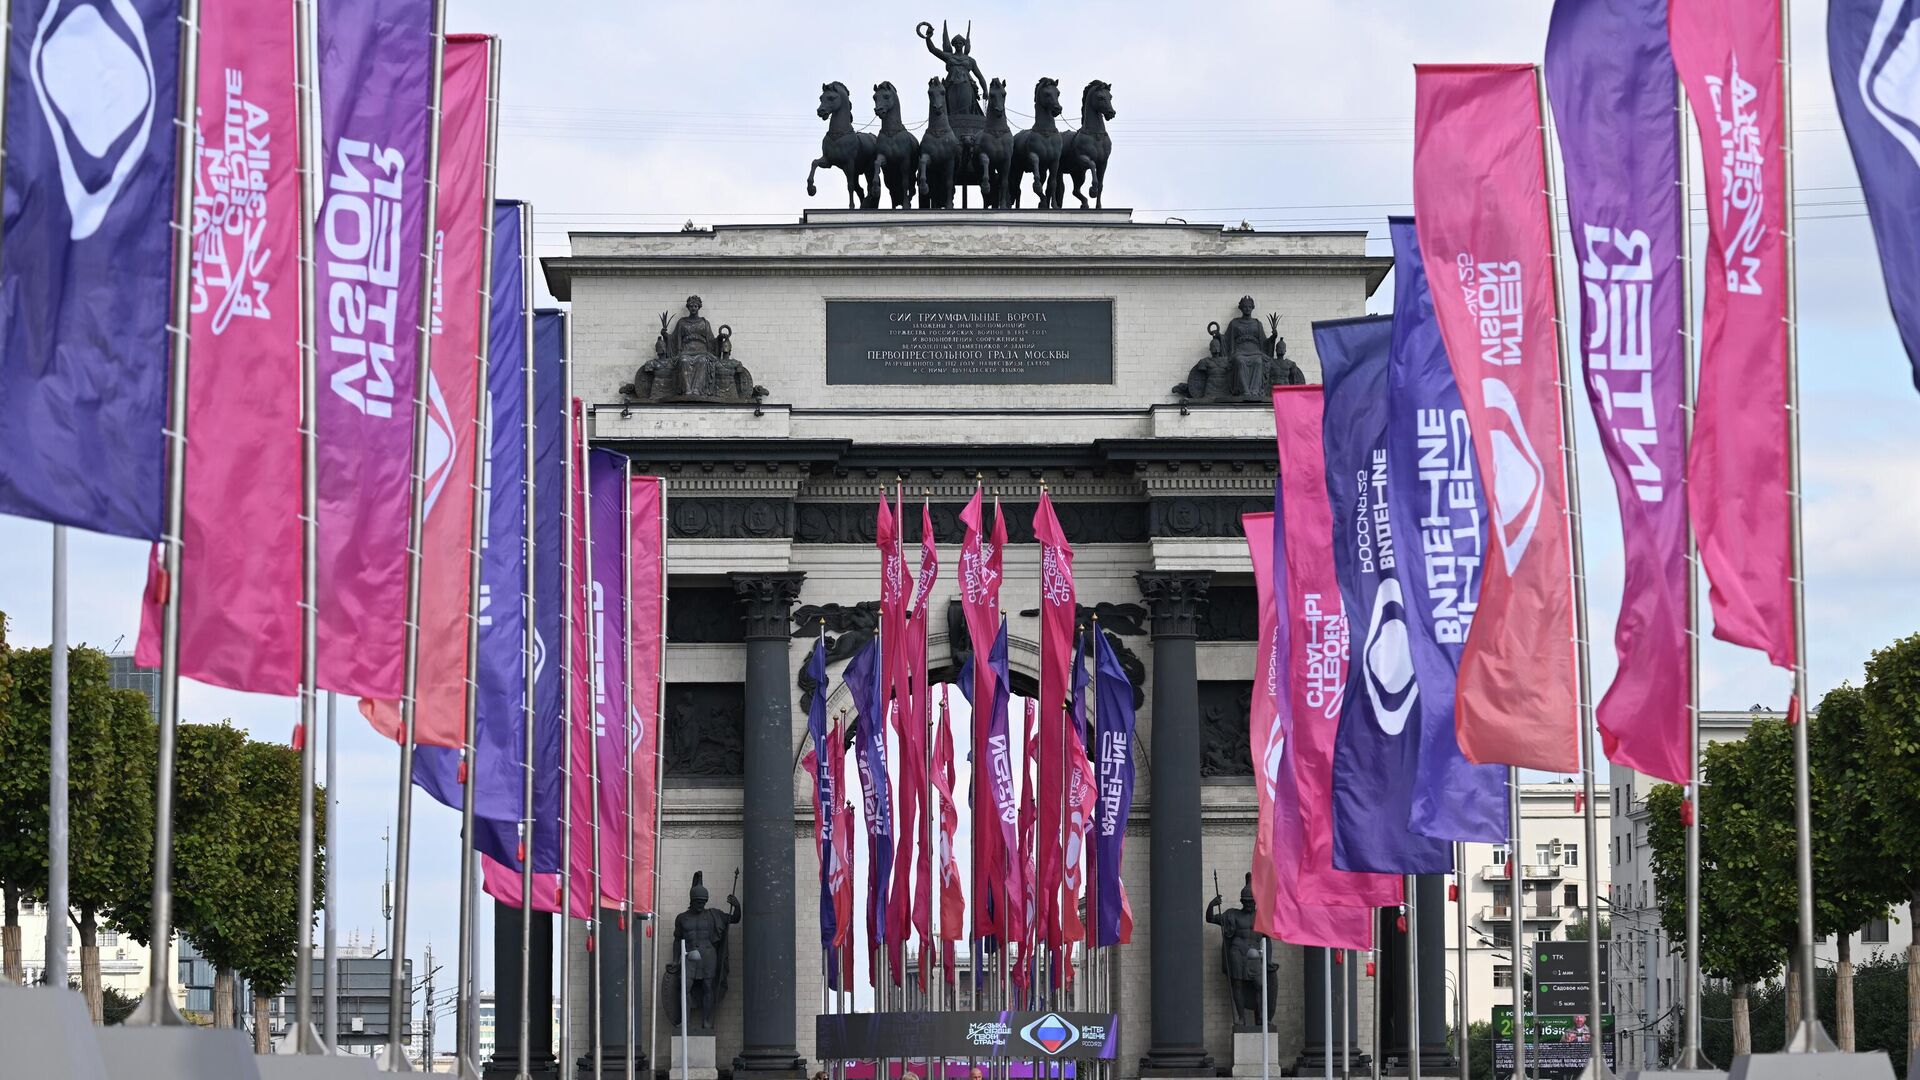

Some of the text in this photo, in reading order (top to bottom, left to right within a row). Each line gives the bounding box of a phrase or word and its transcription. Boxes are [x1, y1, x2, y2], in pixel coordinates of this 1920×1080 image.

[889, 312, 1047, 322] СИИ ТРИУМФАЛЬНЫЕ ВОРОТА
[867, 350, 1070, 360] ПЕРВОПРЕСТОЛЬНОГО ГРАДА МОСКВЫ
